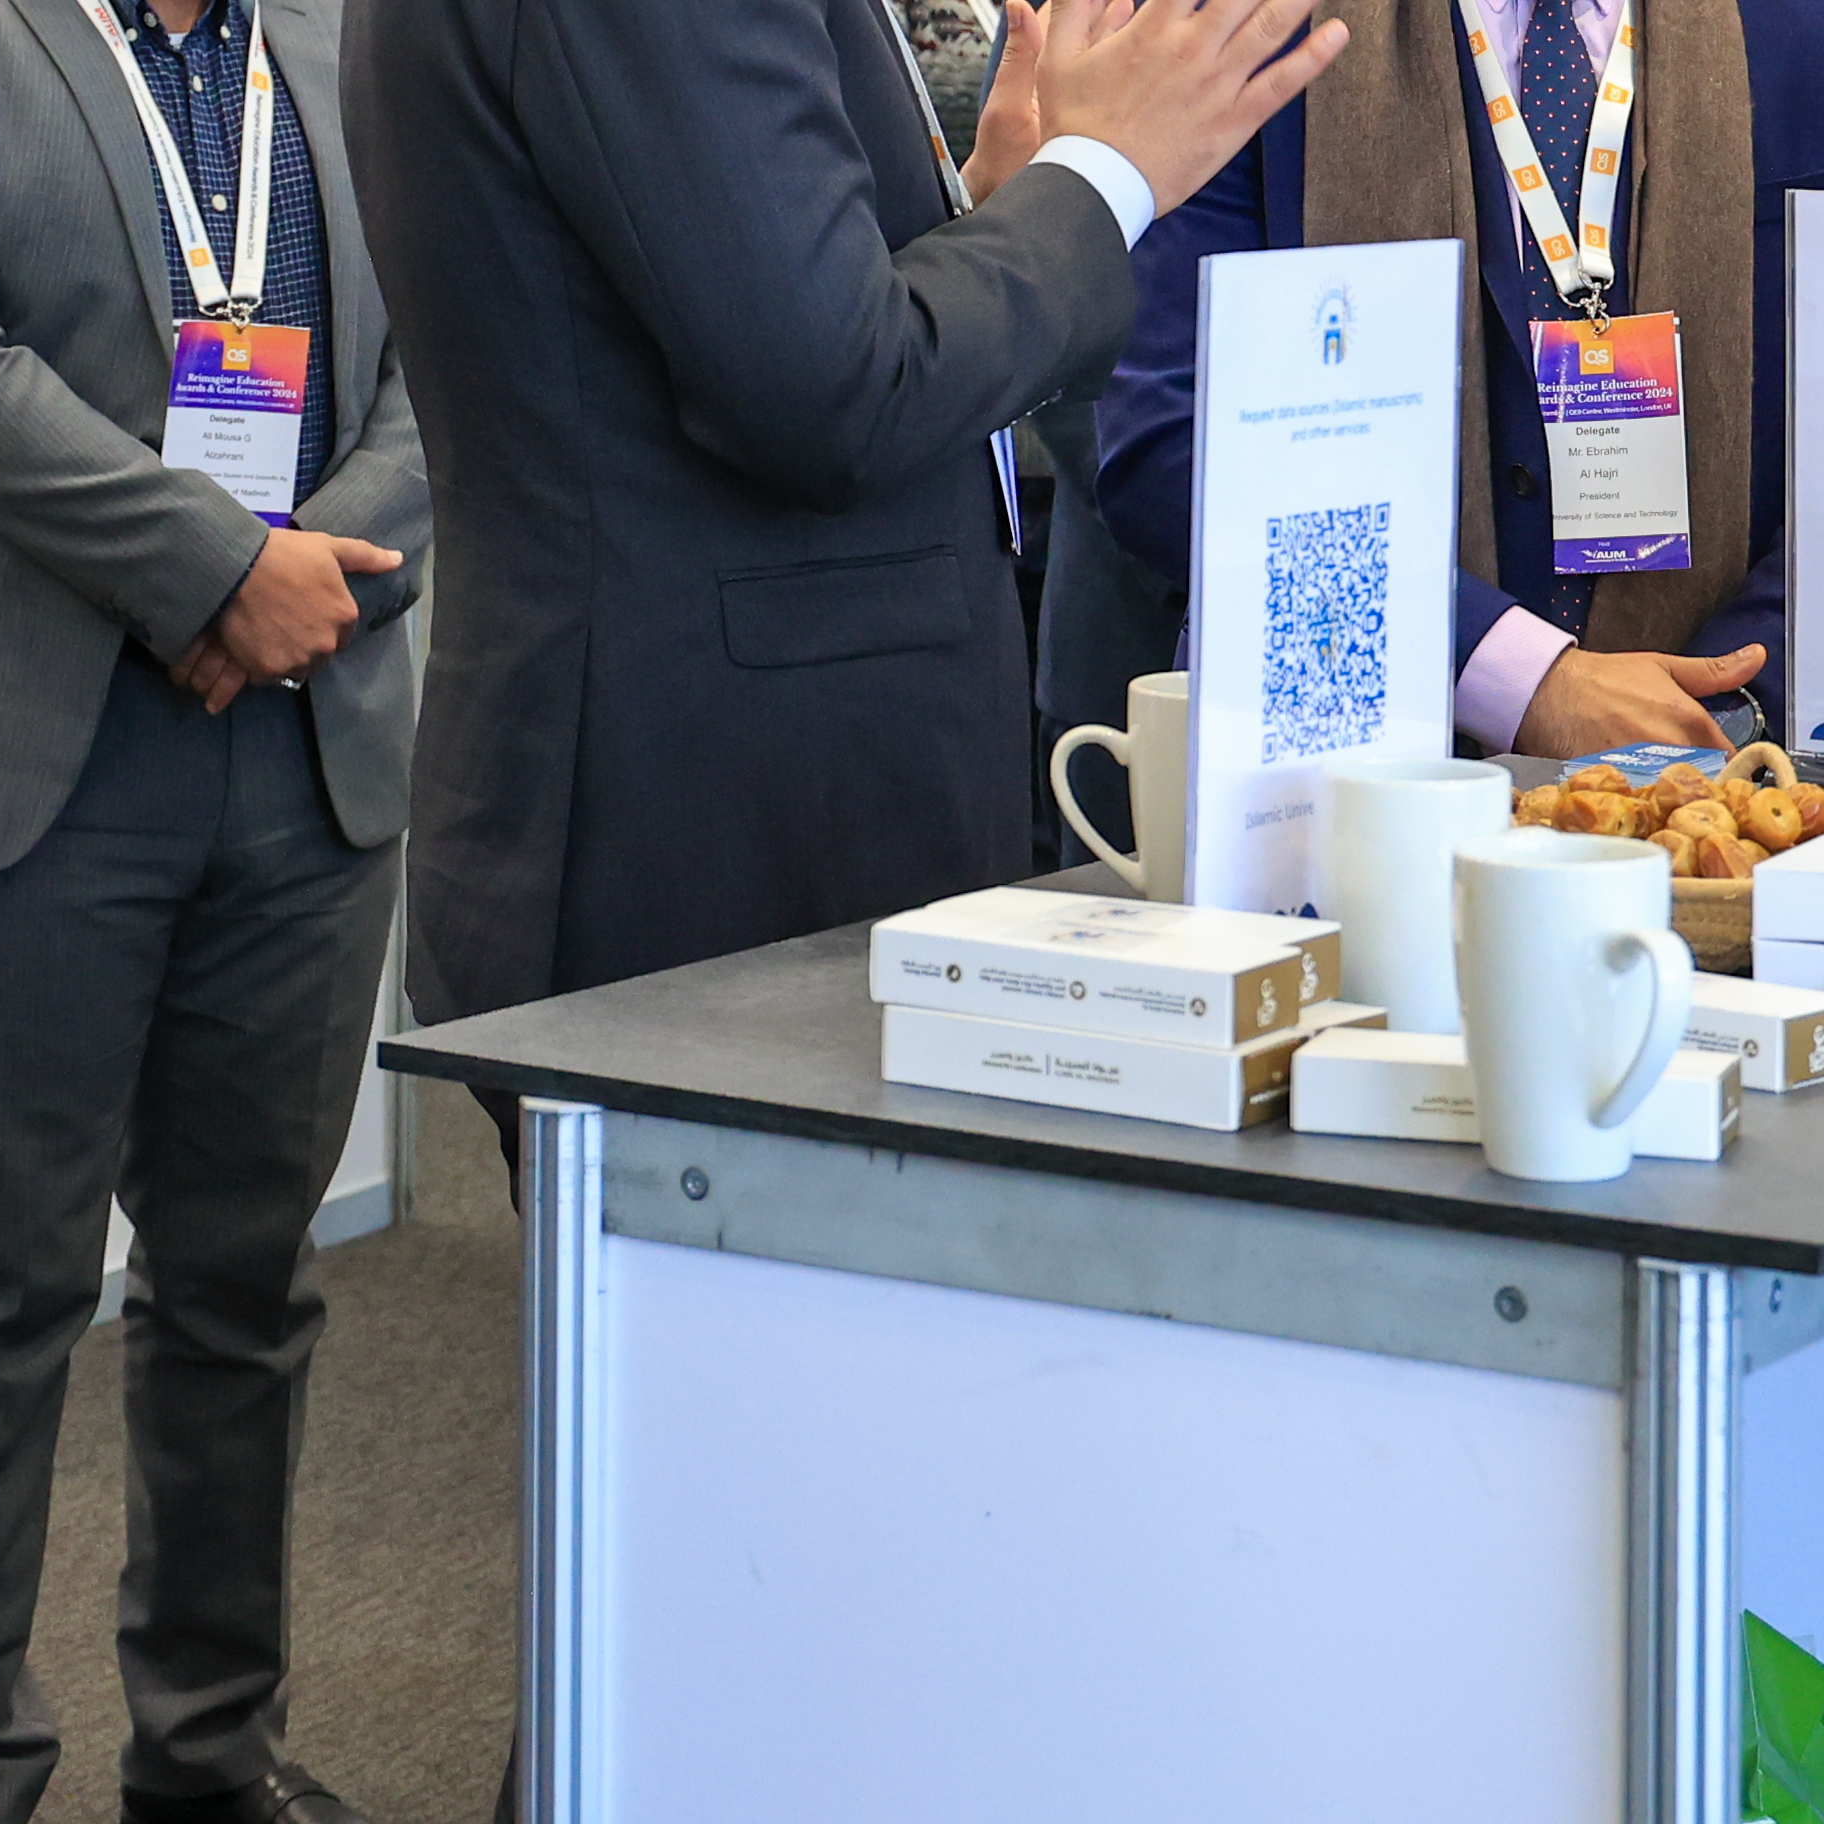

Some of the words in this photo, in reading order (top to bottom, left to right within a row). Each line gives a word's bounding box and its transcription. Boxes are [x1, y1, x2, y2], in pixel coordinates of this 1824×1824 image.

[253, 94, 261, 127] Reimagine
[1491, 100, 1508, 119] QS
[252, 130, 260, 163] Education
[1595, 151, 1610, 171] QS
[1519, 168, 1537, 188] QS
[178, 203, 199, 243] Reimagine
[248, 201, 256, 239] Conference
[1589, 228, 1601, 245] QS
[1549, 237, 1567, 258] QS
[226, 347, 249, 363] QS
[1584, 348, 1610, 366] QS
[186, 372, 236, 386] Reimagine
[236, 375, 286, 388] Education
[1537, 380, 1598, 394] Reimagine
[1601, 377, 1658, 391] Education
[207, 383, 216, 393] &
[216, 384, 272, 397] Conference
[272, 387, 298, 399] 2024
[1565, 394, 1575, 404] &
[1577, 390, 1644, 404] Conference
[1644, 387, 1674, 399] 2024
[209, 414, 246, 425] Delegate
[214, 432, 243, 442] Mousa
[1576, 426, 1620, 437] Delegate
[1568, 447, 1583, 457] Mr.
[1586, 446, 1629, 457] Ebrahim
[1580, 469, 1591, 479] Al
[1594, 468, 1619, 480] Hajri
[1579, 492, 1620, 501] President
[1585, 512, 1592, 520] of
[1594, 512, 1622, 520] Science
[1623, 511, 1636, 519] and
[1638, 509, 1678, 518] Technology
[1595, 550, 1626, 559] AUM
[1245, 805, 1284, 830] Islamic
